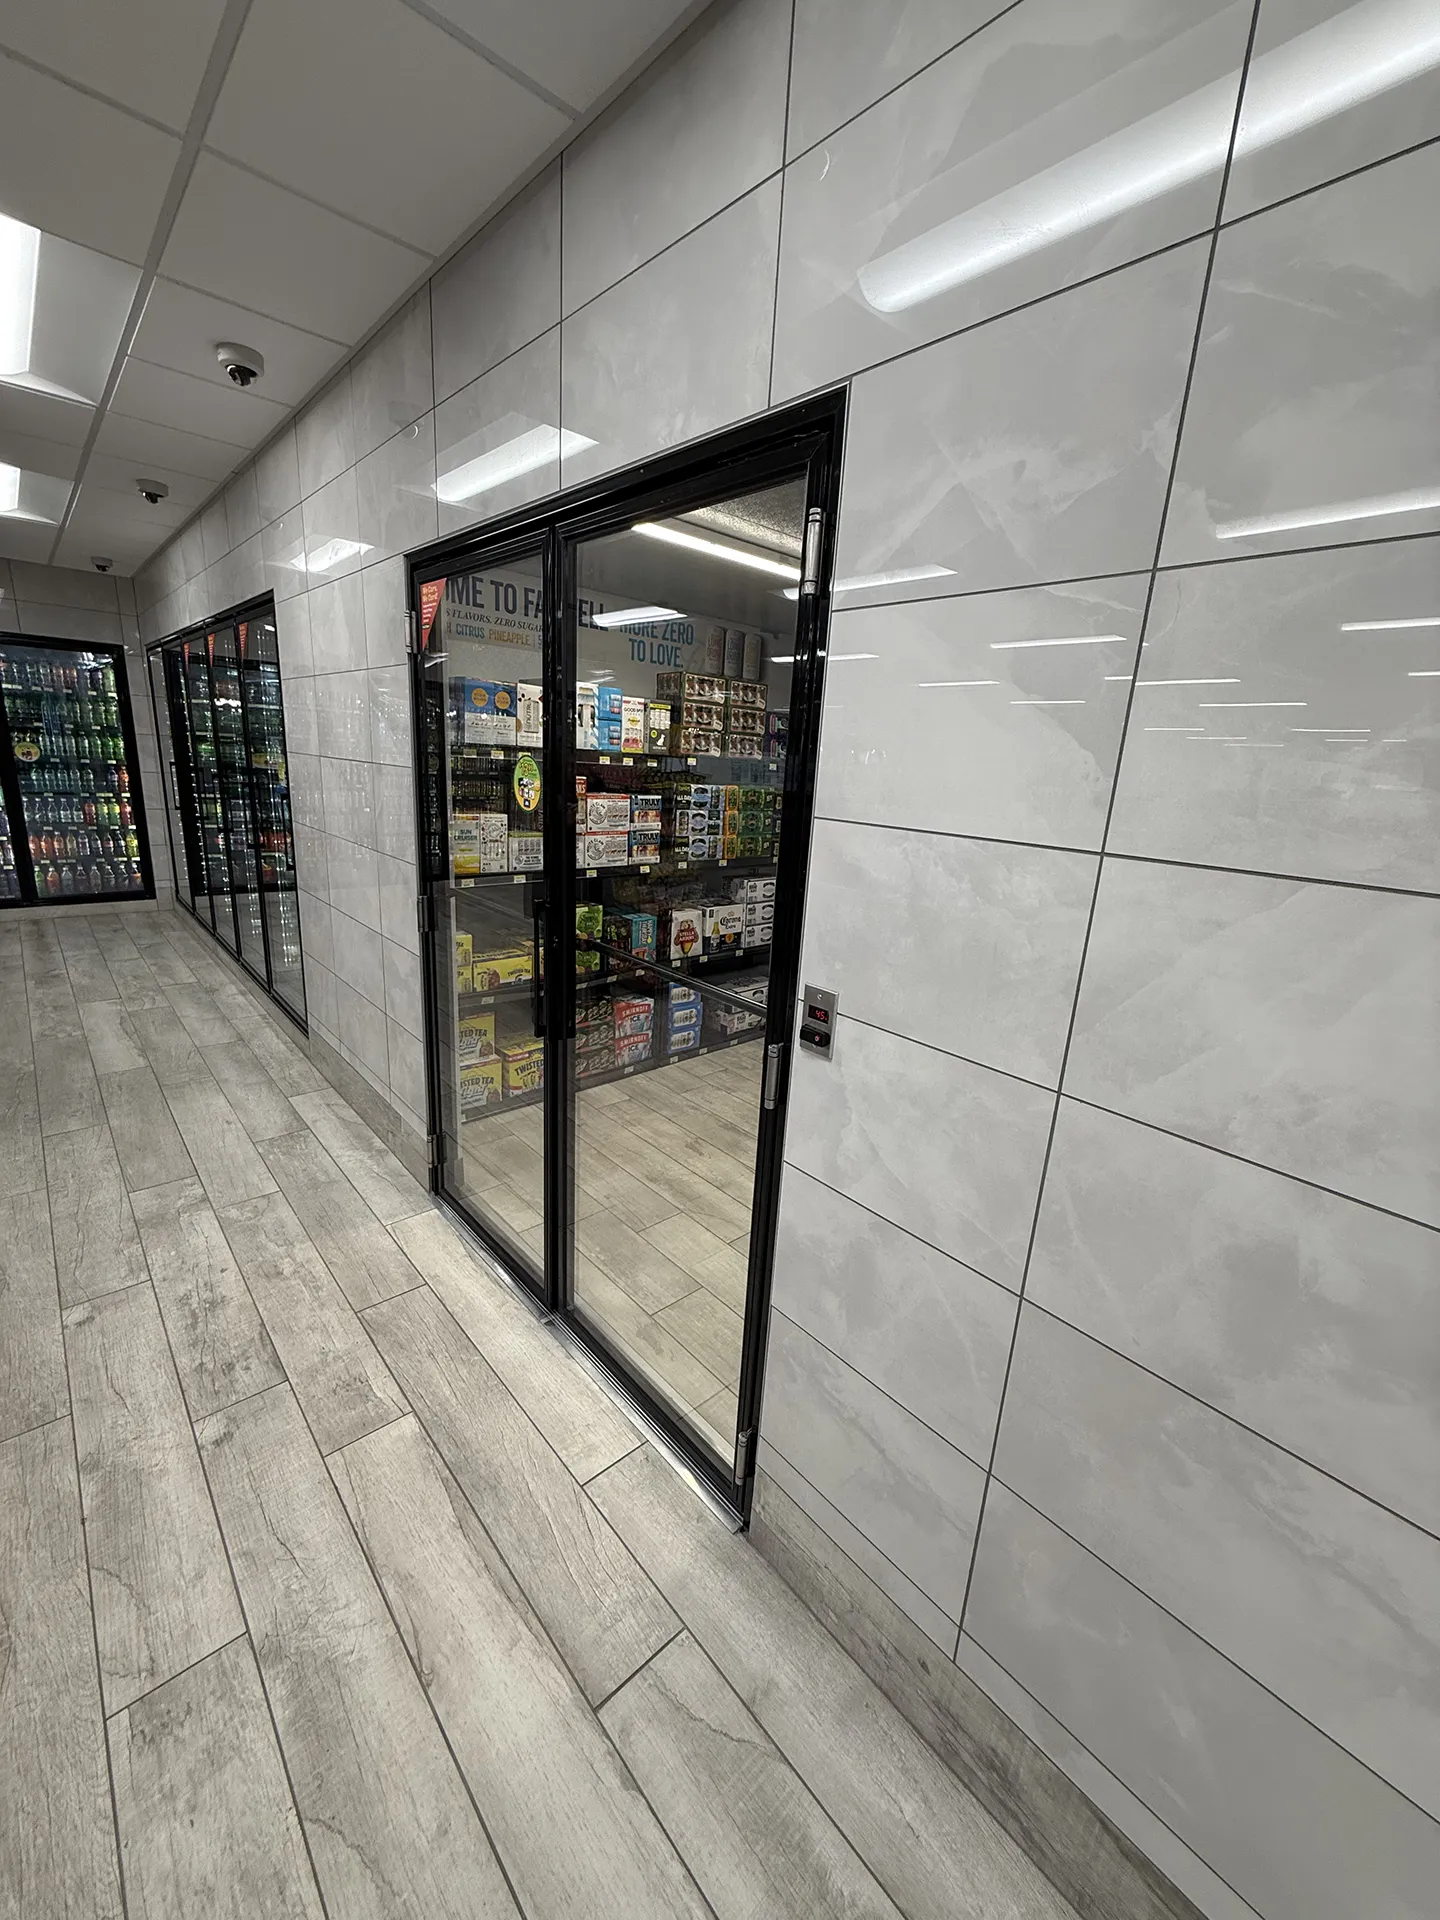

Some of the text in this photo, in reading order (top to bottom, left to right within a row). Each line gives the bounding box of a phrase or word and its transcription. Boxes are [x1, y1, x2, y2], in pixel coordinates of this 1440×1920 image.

[490, 580, 517, 615] TO
[494, 615, 516, 628] ZERO
[456, 623, 485, 639] CITRUS
[488, 628, 531, 646] PINEAPPLE
[662, 619, 694, 646] ZERO
[629, 638, 646, 662] TO
[650, 641, 684, 668] LOVE.
[640, 798, 660, 807] TRULY
[639, 833, 659, 841] TRULY
[720, 916, 741, 926] Corona
[621, 1005, 649, 1016] SMIRNOFF
[459, 1028, 488, 1039] TED TEA
[620, 1034, 647, 1045] SMIRNOFF
[481, 1076, 494, 1085] TEA
